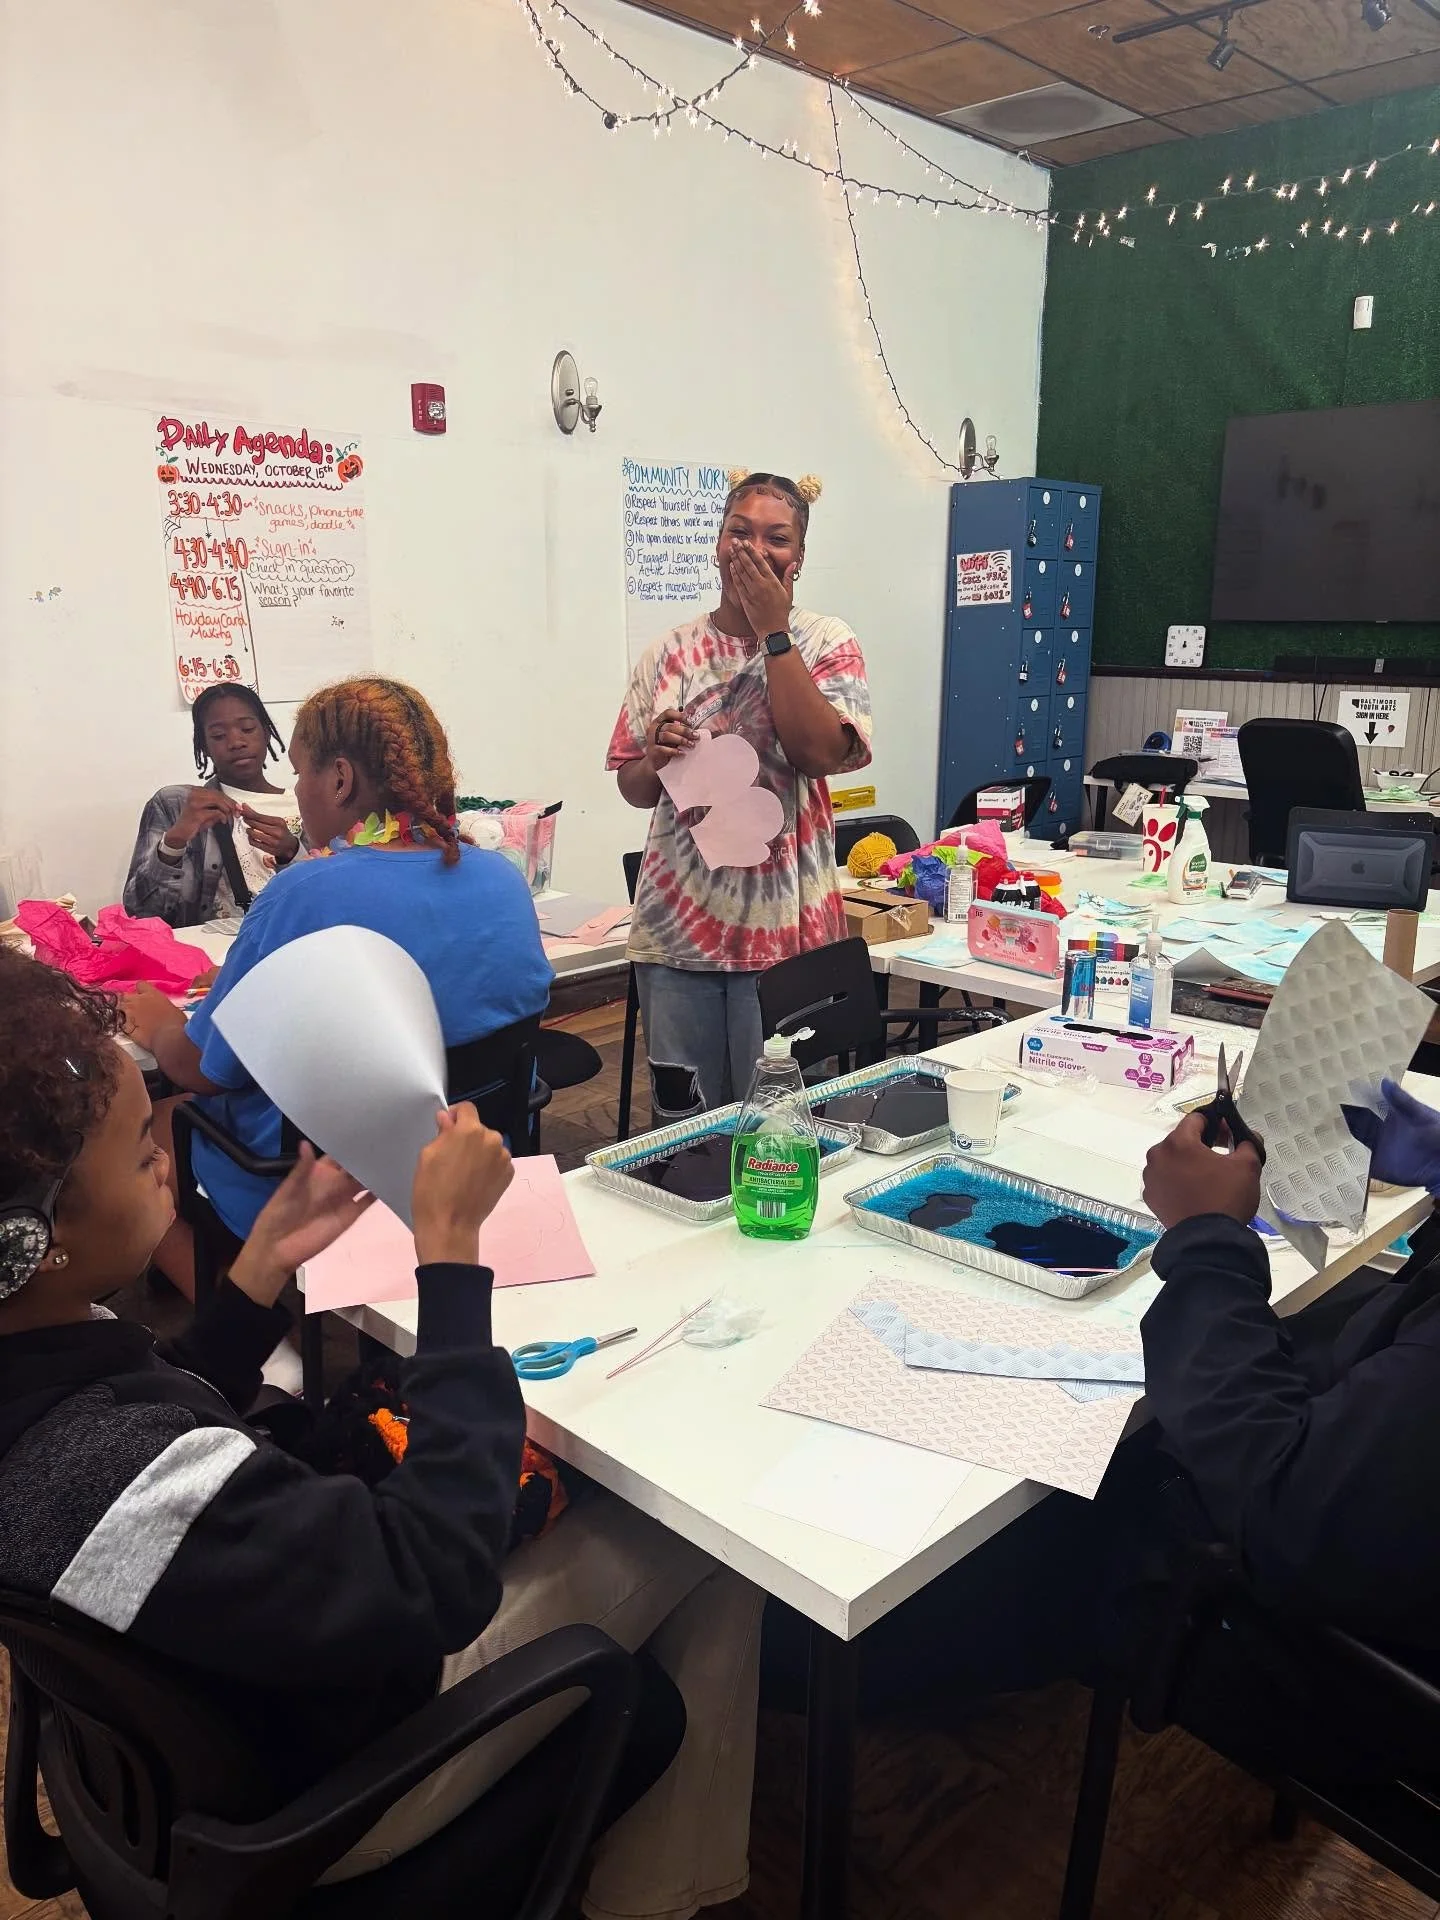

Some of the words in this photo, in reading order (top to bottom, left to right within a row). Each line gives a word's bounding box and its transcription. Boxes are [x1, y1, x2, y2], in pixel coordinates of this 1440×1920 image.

[233, 426, 334, 465] Agenda:
[186, 457, 259, 478] WEDNESDAY,
[265, 465, 315, 480] OCTOBER
[315, 465, 333, 480] 15th
[629, 463, 689, 488] COMMUNITY
[699, 467, 730, 491] NORM
[259, 501, 307, 519] Snacks,
[660, 496, 691, 512] Yourself
[694, 503, 706, 512] and
[635, 532, 645, 543] No
[638, 548, 668, 565] Engaged
[250, 560, 279, 573] Check
[286, 563, 295, 573] in
[300, 562, 348, 578] question
[251, 581, 290, 596] What's
[292, 585, 314, 602] your
[320, 584, 355, 598] favorite
[637, 578, 661, 593] Respect
[190, 627, 232, 647] Making
[178, 655, 241, 679] 6:15-6:30
[1029, 1055, 1056, 1067] Nitrile
[747, 1157, 799, 1173] Radiance
